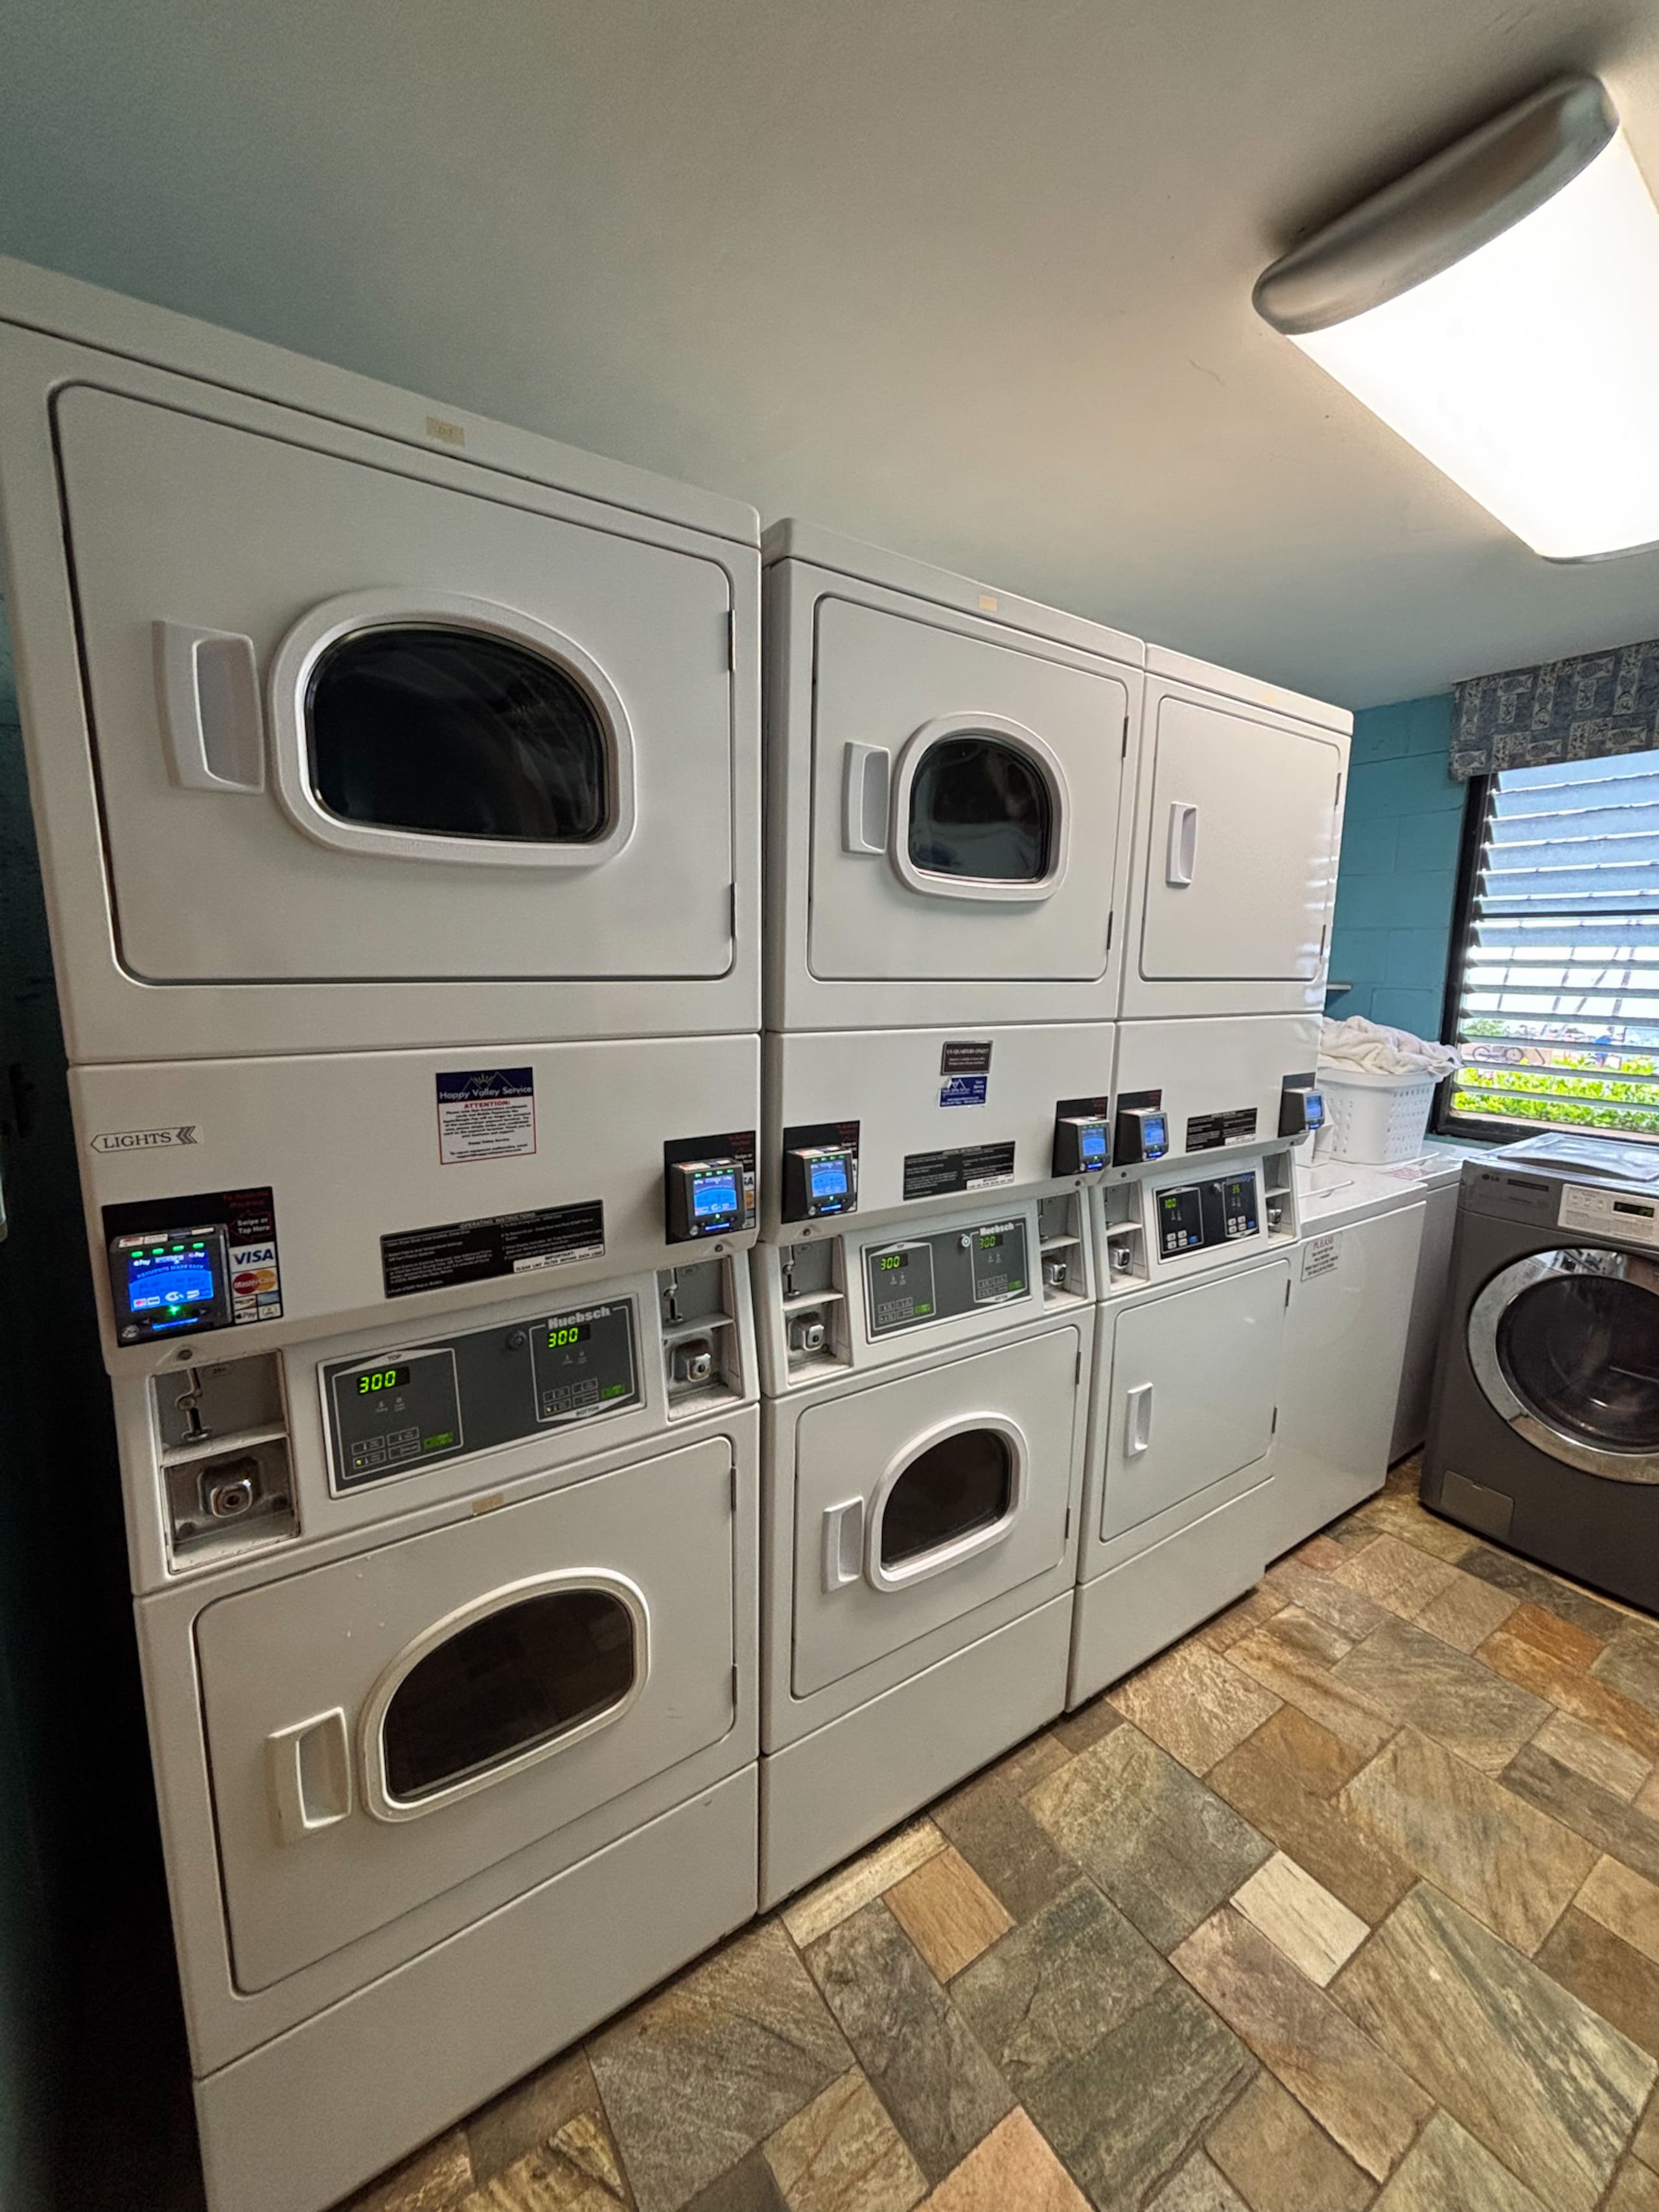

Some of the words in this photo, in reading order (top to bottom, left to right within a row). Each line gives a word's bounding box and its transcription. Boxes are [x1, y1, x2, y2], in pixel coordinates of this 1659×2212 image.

[439, 1091, 470, 1100] Happy
[472, 1088, 500, 1097] Valley
[502, 1086, 532, 1095] Service
[464, 1100, 510, 1109] ATTENTION:
[104, 1132, 172, 1149] LIGHTS
[237, 1218, 259, 1227] Swipe
[979, 1222, 1015, 1236] Huebsch
[237, 1226, 252, 1235] Tap
[979, 1236, 995, 1249] 300
[232, 1248, 273, 1265] VISA
[881, 1255, 900, 1271] 300
[548, 1306, 610, 1329] Huebsch
[548, 1327, 579, 1348] 300
[359, 1370, 396, 1393] 300
